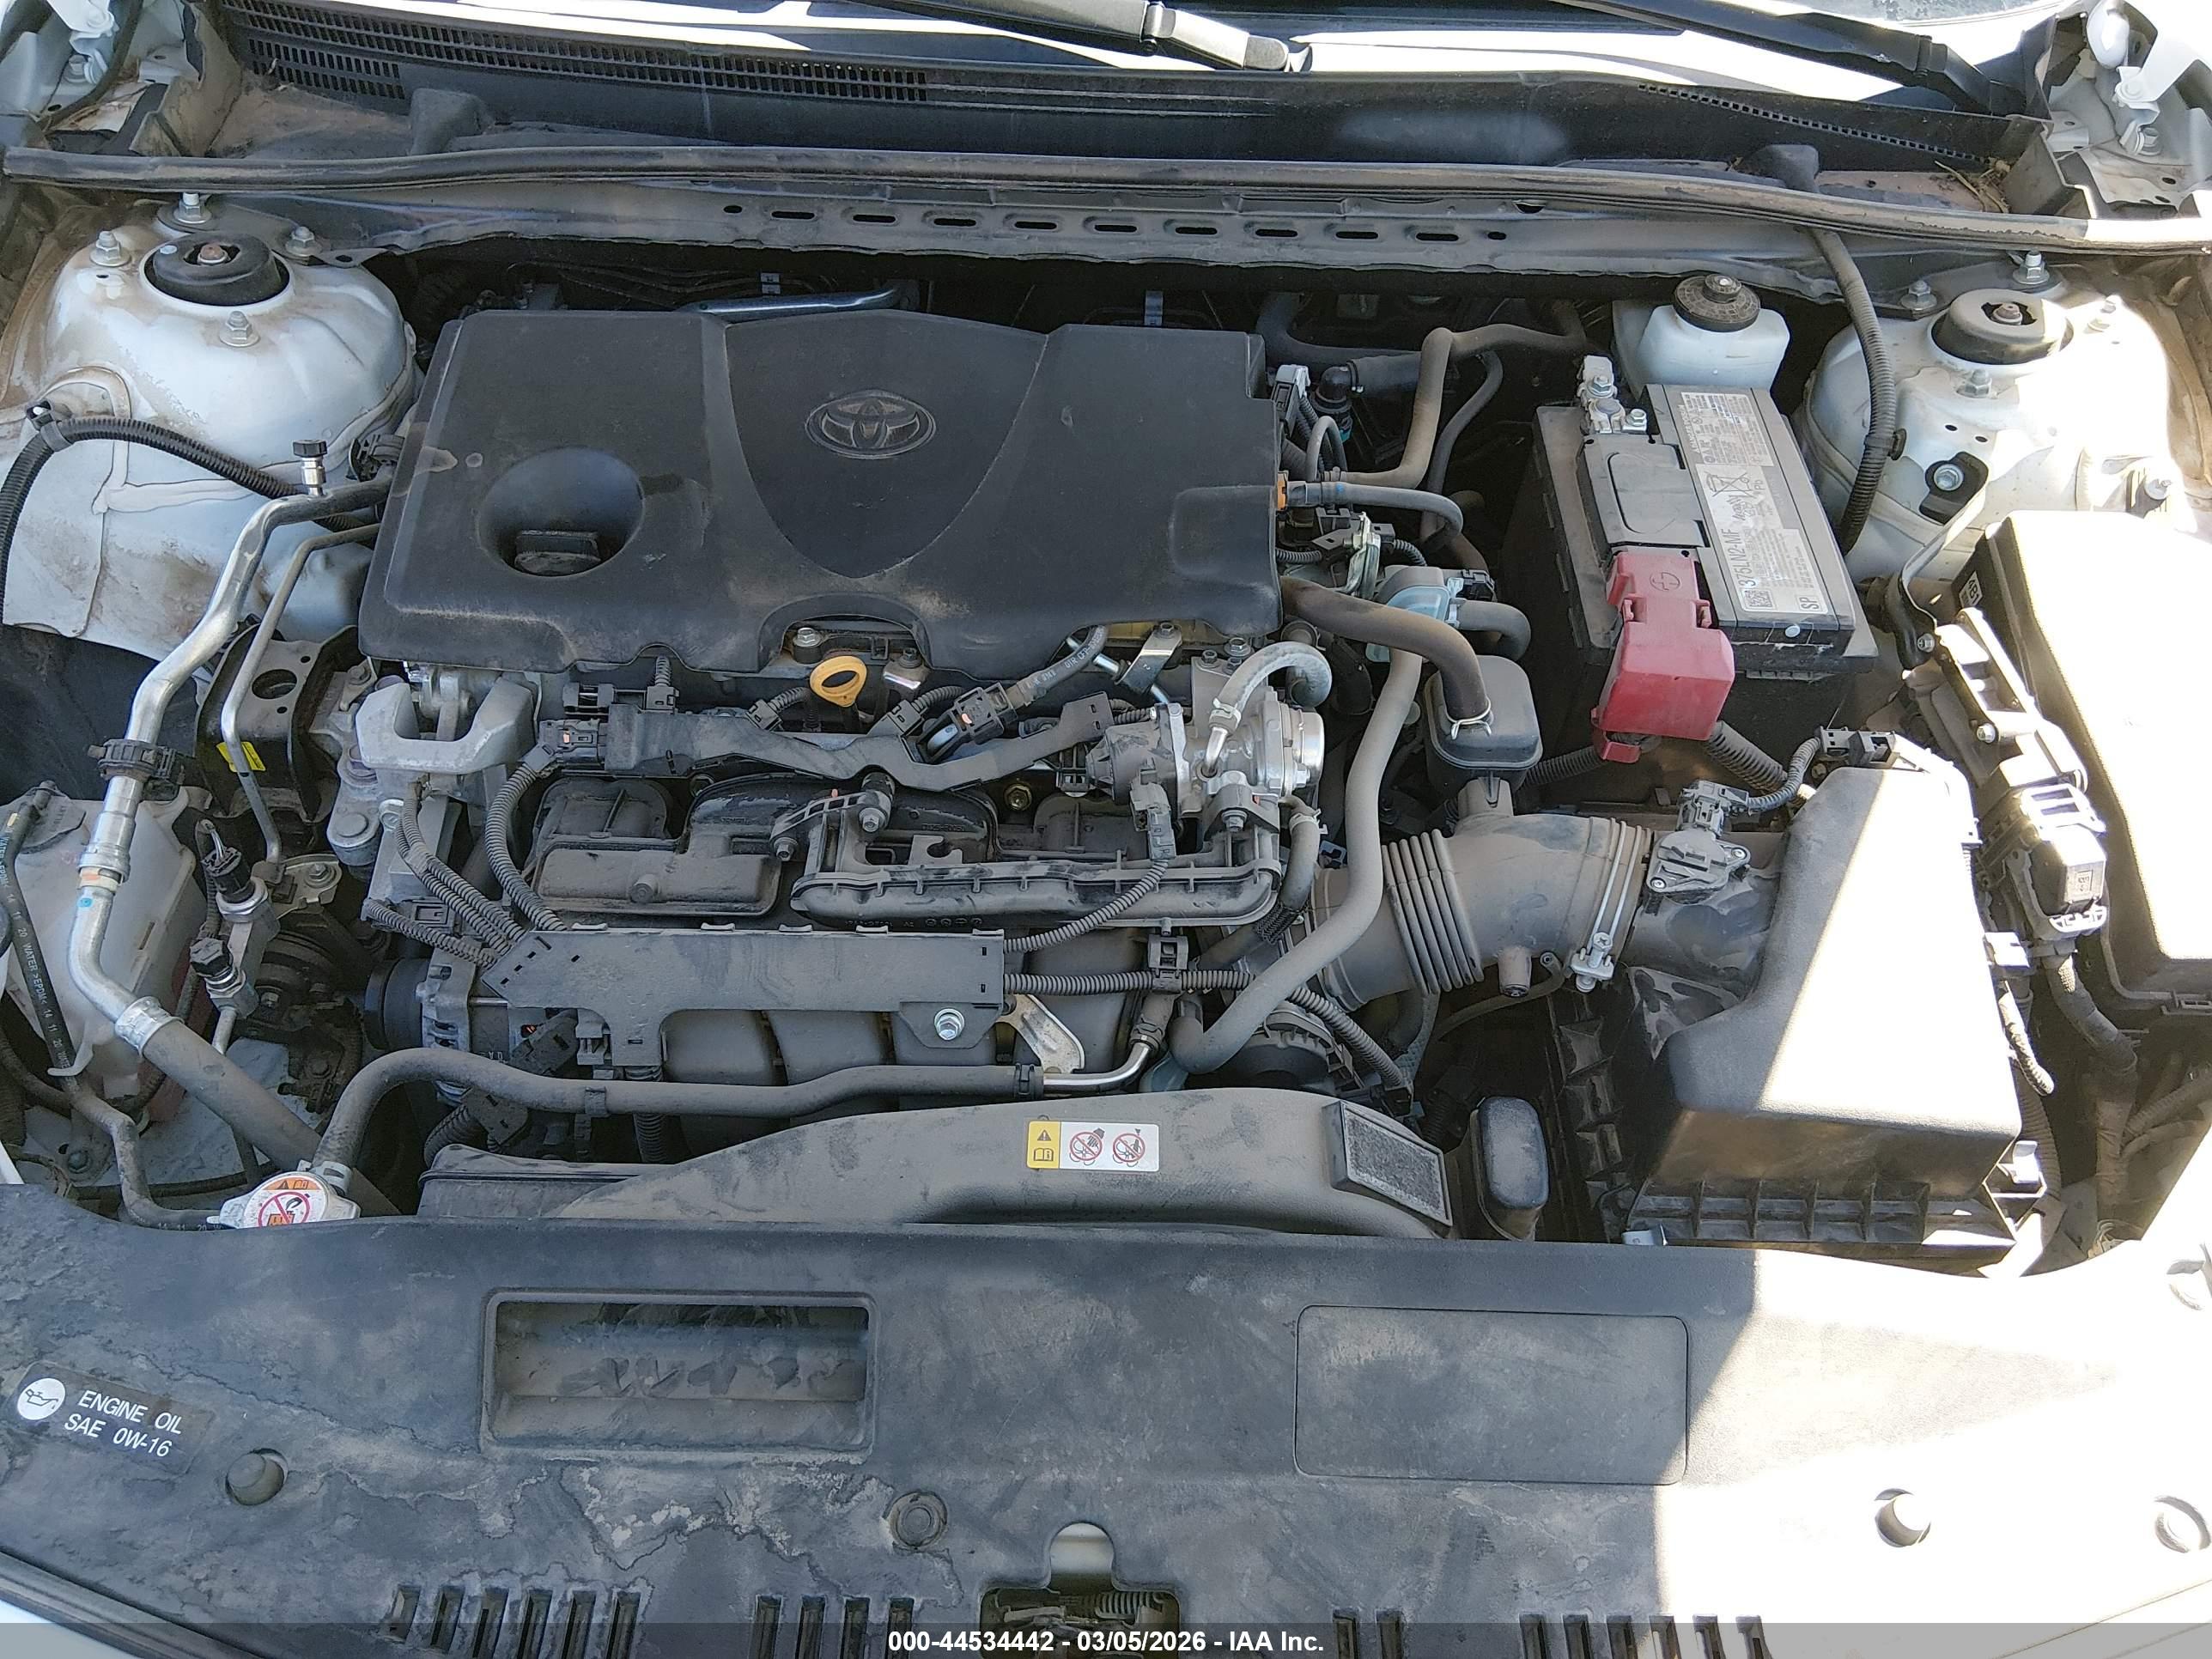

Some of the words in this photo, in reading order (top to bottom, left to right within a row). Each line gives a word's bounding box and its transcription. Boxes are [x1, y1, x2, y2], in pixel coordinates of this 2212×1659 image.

[1754, 479, 1764, 490] Pb
[1721, 528, 1757, 586] 375LN2-MF
[1799, 597, 1820, 610] SP
[22, 942, 39, 972] WATER
[58, 1051, 70, 1069] WATE
[77, 1389, 149, 1423] ENGINE
[155, 1412, 182, 1435] OIL
[64, 1413, 106, 1438] SAE
[112, 1427, 173, 1457] 0W-16
